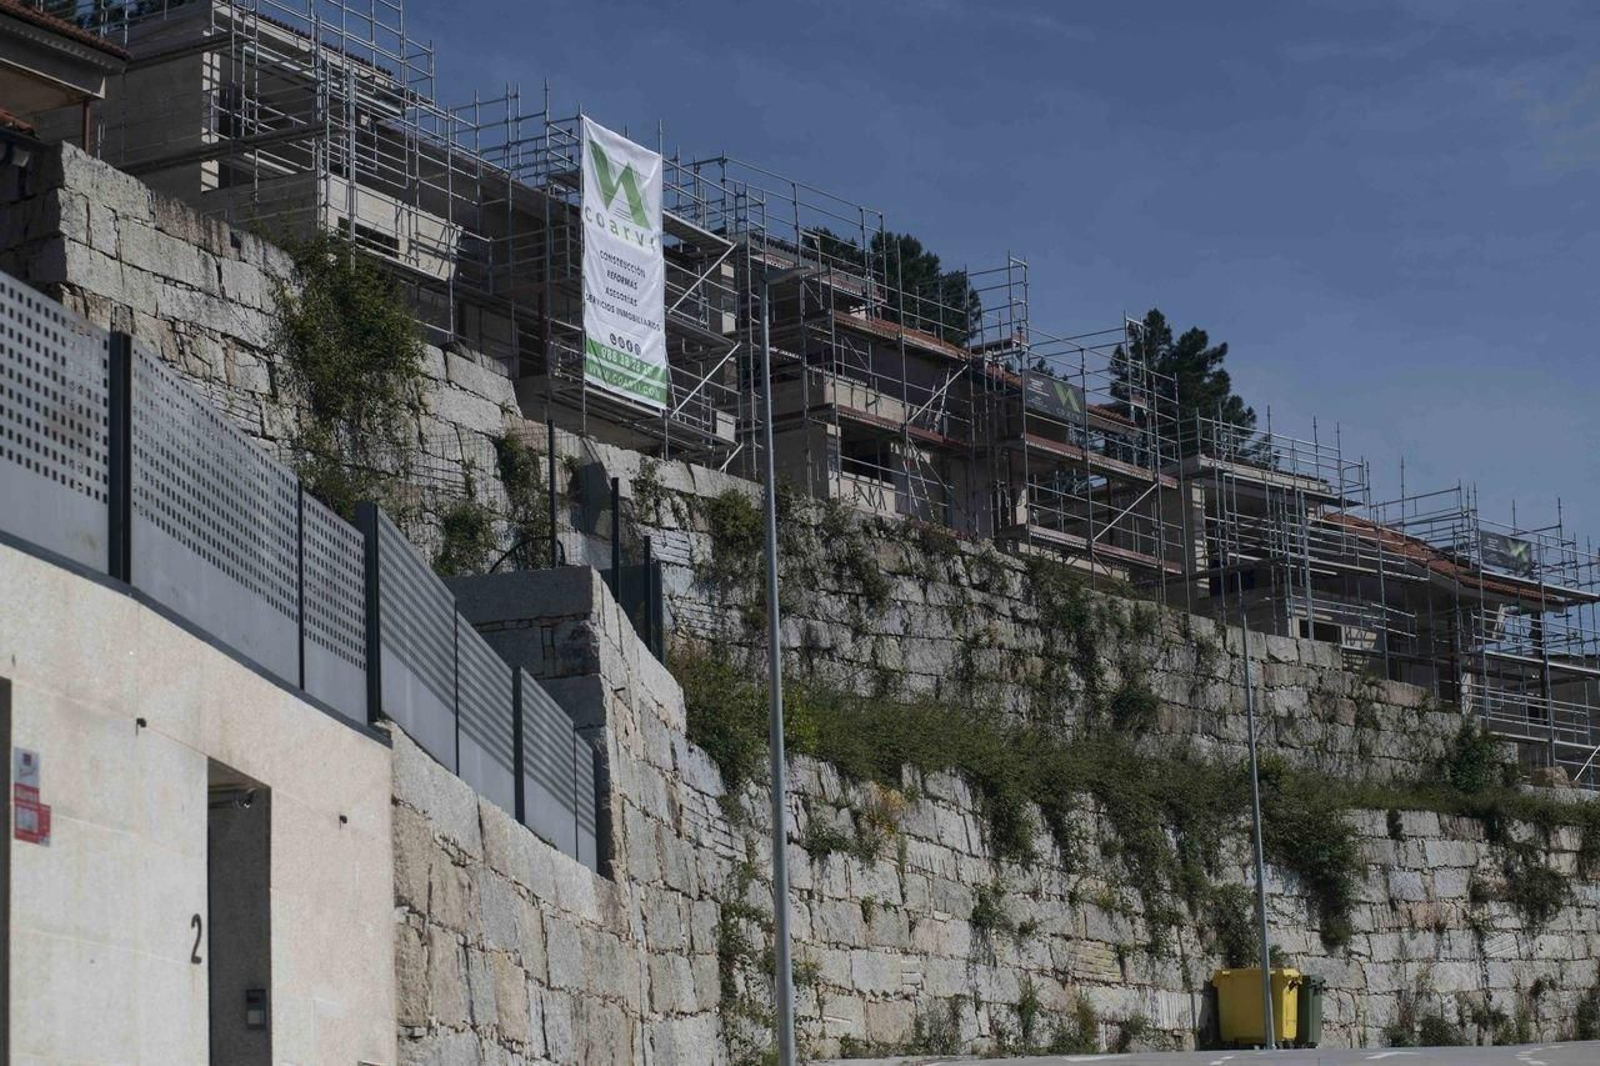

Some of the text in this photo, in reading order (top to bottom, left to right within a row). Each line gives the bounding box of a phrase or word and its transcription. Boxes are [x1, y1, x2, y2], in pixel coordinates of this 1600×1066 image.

[600, 250, 646, 279] CONSTRUCCIÓN
[606, 269, 638, 291] REFORMAS
[191, 913, 202, 964] 2
